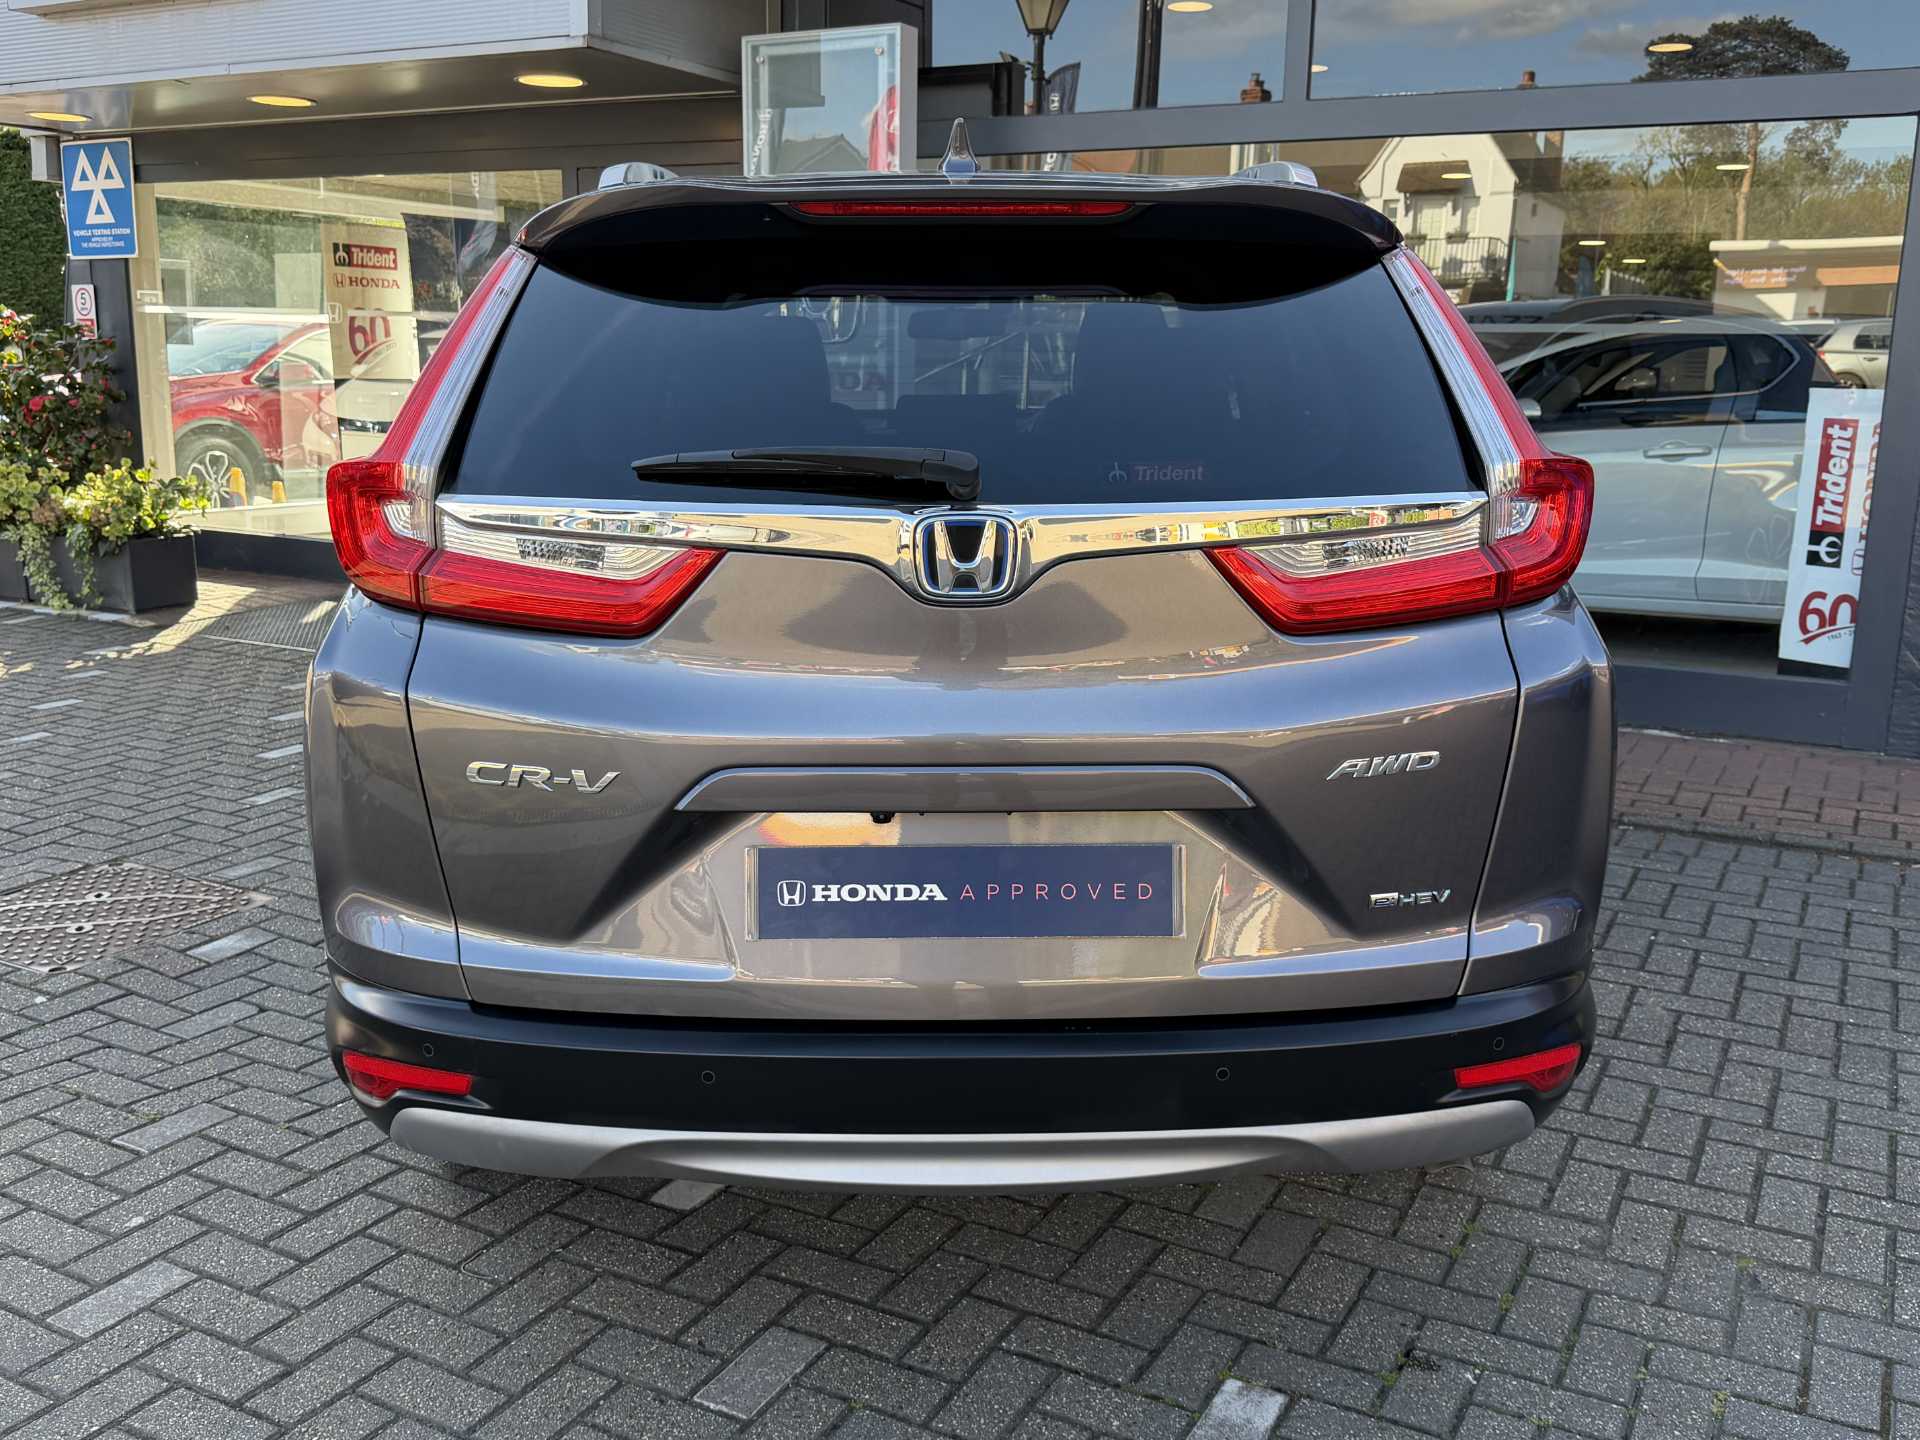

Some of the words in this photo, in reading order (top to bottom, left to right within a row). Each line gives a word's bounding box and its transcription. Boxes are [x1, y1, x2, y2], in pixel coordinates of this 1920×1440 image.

[351, 247, 396, 268] Trident
[348, 276, 400, 289] HONDA
[80, 292, 87, 305] 5
[1133, 464, 1204, 481] Trident
[1815, 424, 1853, 526] Trident
[1326, 750, 1440, 780] AWD
[465, 761, 621, 794] CR-V
[812, 884, 948, 902] HONDA
[960, 883, 1153, 900] APPROVED
